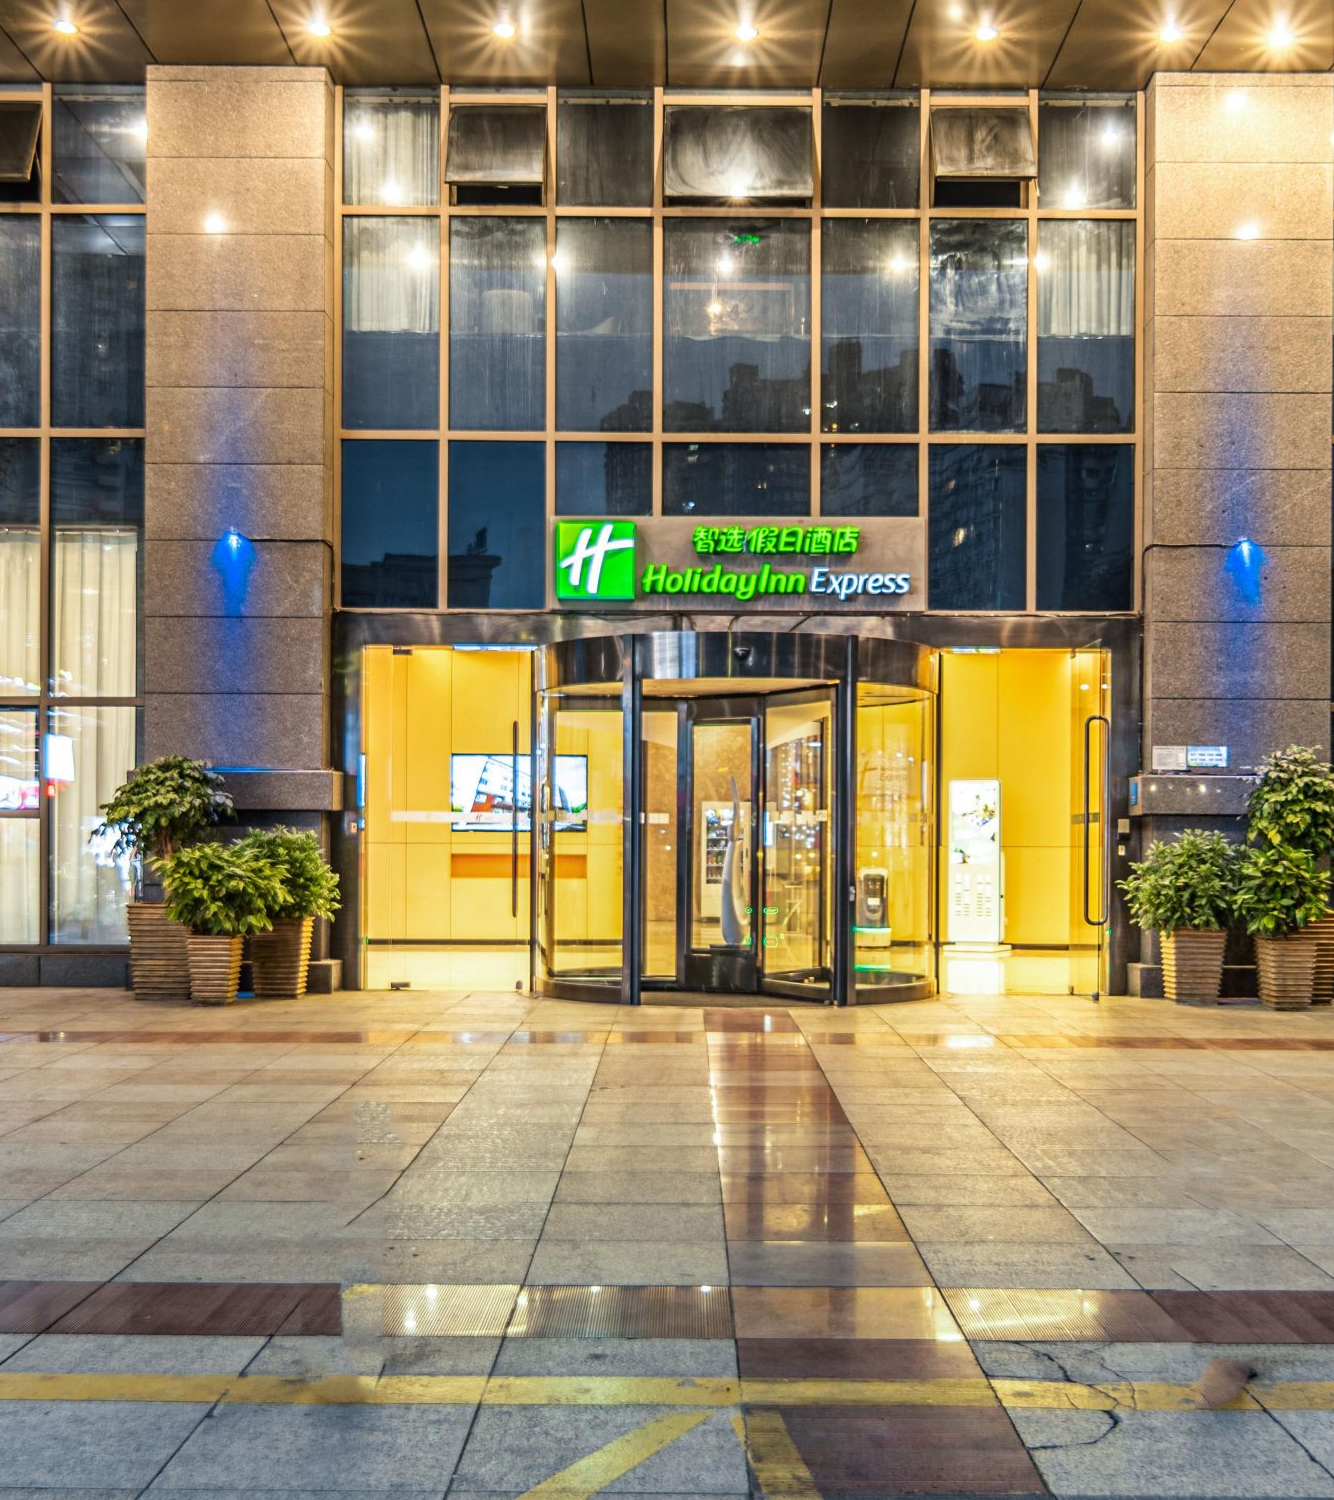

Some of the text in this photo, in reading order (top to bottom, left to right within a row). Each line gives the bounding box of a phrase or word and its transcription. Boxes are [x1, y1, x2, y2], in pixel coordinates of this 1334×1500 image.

[691, 522, 862, 555] 智选假日酒店
[808, 566, 912, 601] Express
